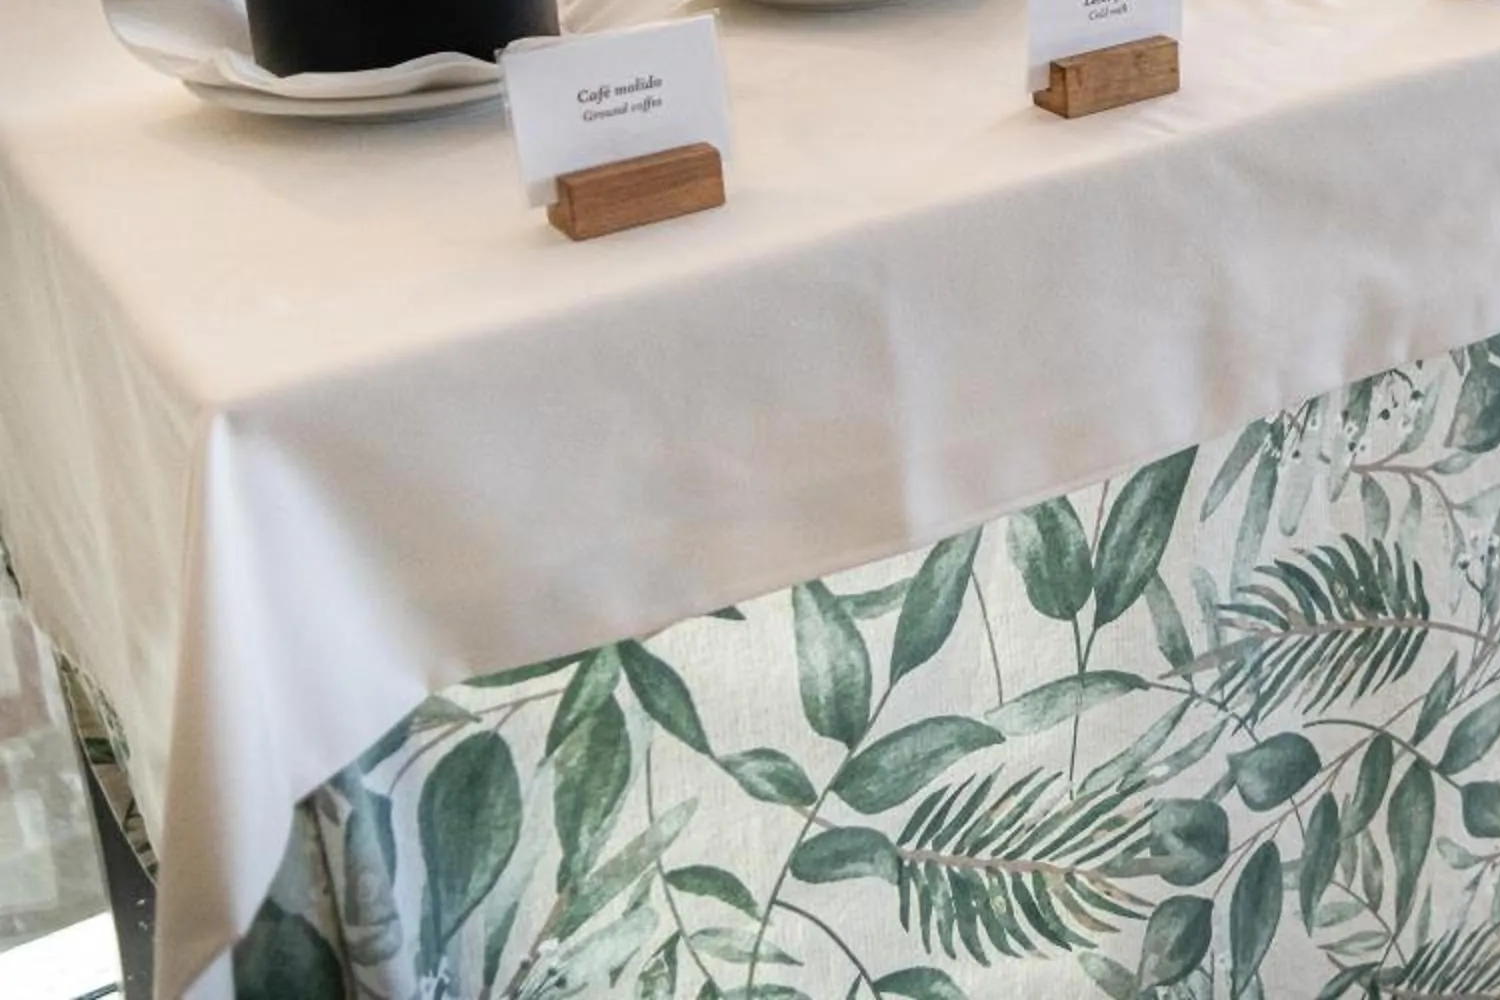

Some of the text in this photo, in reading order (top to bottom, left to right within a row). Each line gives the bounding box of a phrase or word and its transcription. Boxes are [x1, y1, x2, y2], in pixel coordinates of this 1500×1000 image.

[577, 75, 663, 104] Café molido
[583, 102, 628, 121] Ground
